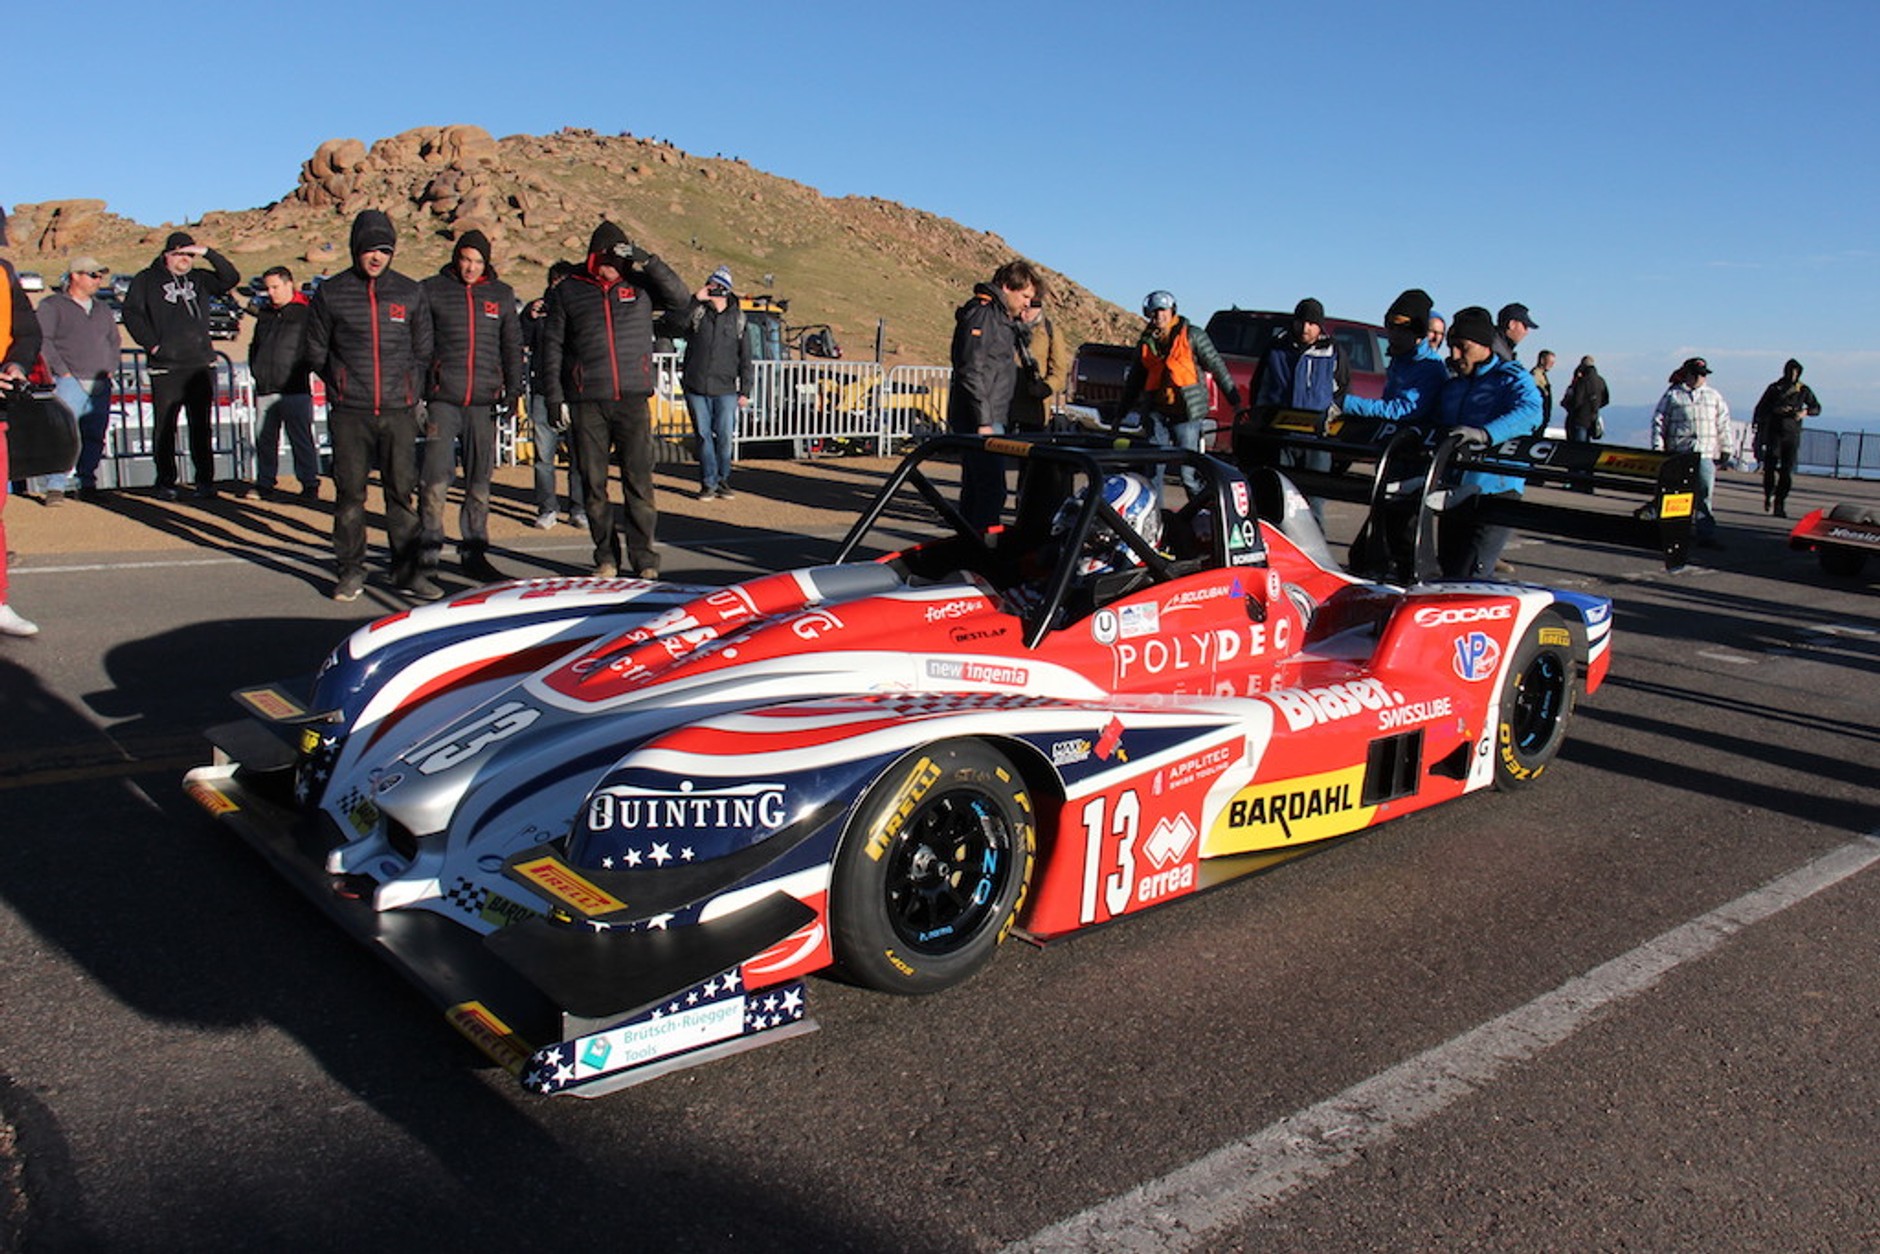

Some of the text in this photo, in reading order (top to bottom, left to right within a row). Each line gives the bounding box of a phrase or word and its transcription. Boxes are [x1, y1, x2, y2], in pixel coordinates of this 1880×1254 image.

[1414, 605, 1512, 627] SOCAGE
[930, 661, 1027, 686] new ingenia
[1378, 697, 1452, 730] SWISSLUBE
[1168, 747, 1230, 780] APPLITEC
[864, 756, 943, 862] PIRELLI
[1228, 783, 1353, 839] BARDAHL
[1079, 788, 1141, 925] 13
[530, 864, 612, 909] PIRELLI
[624, 1044, 657, 1062] Tools
